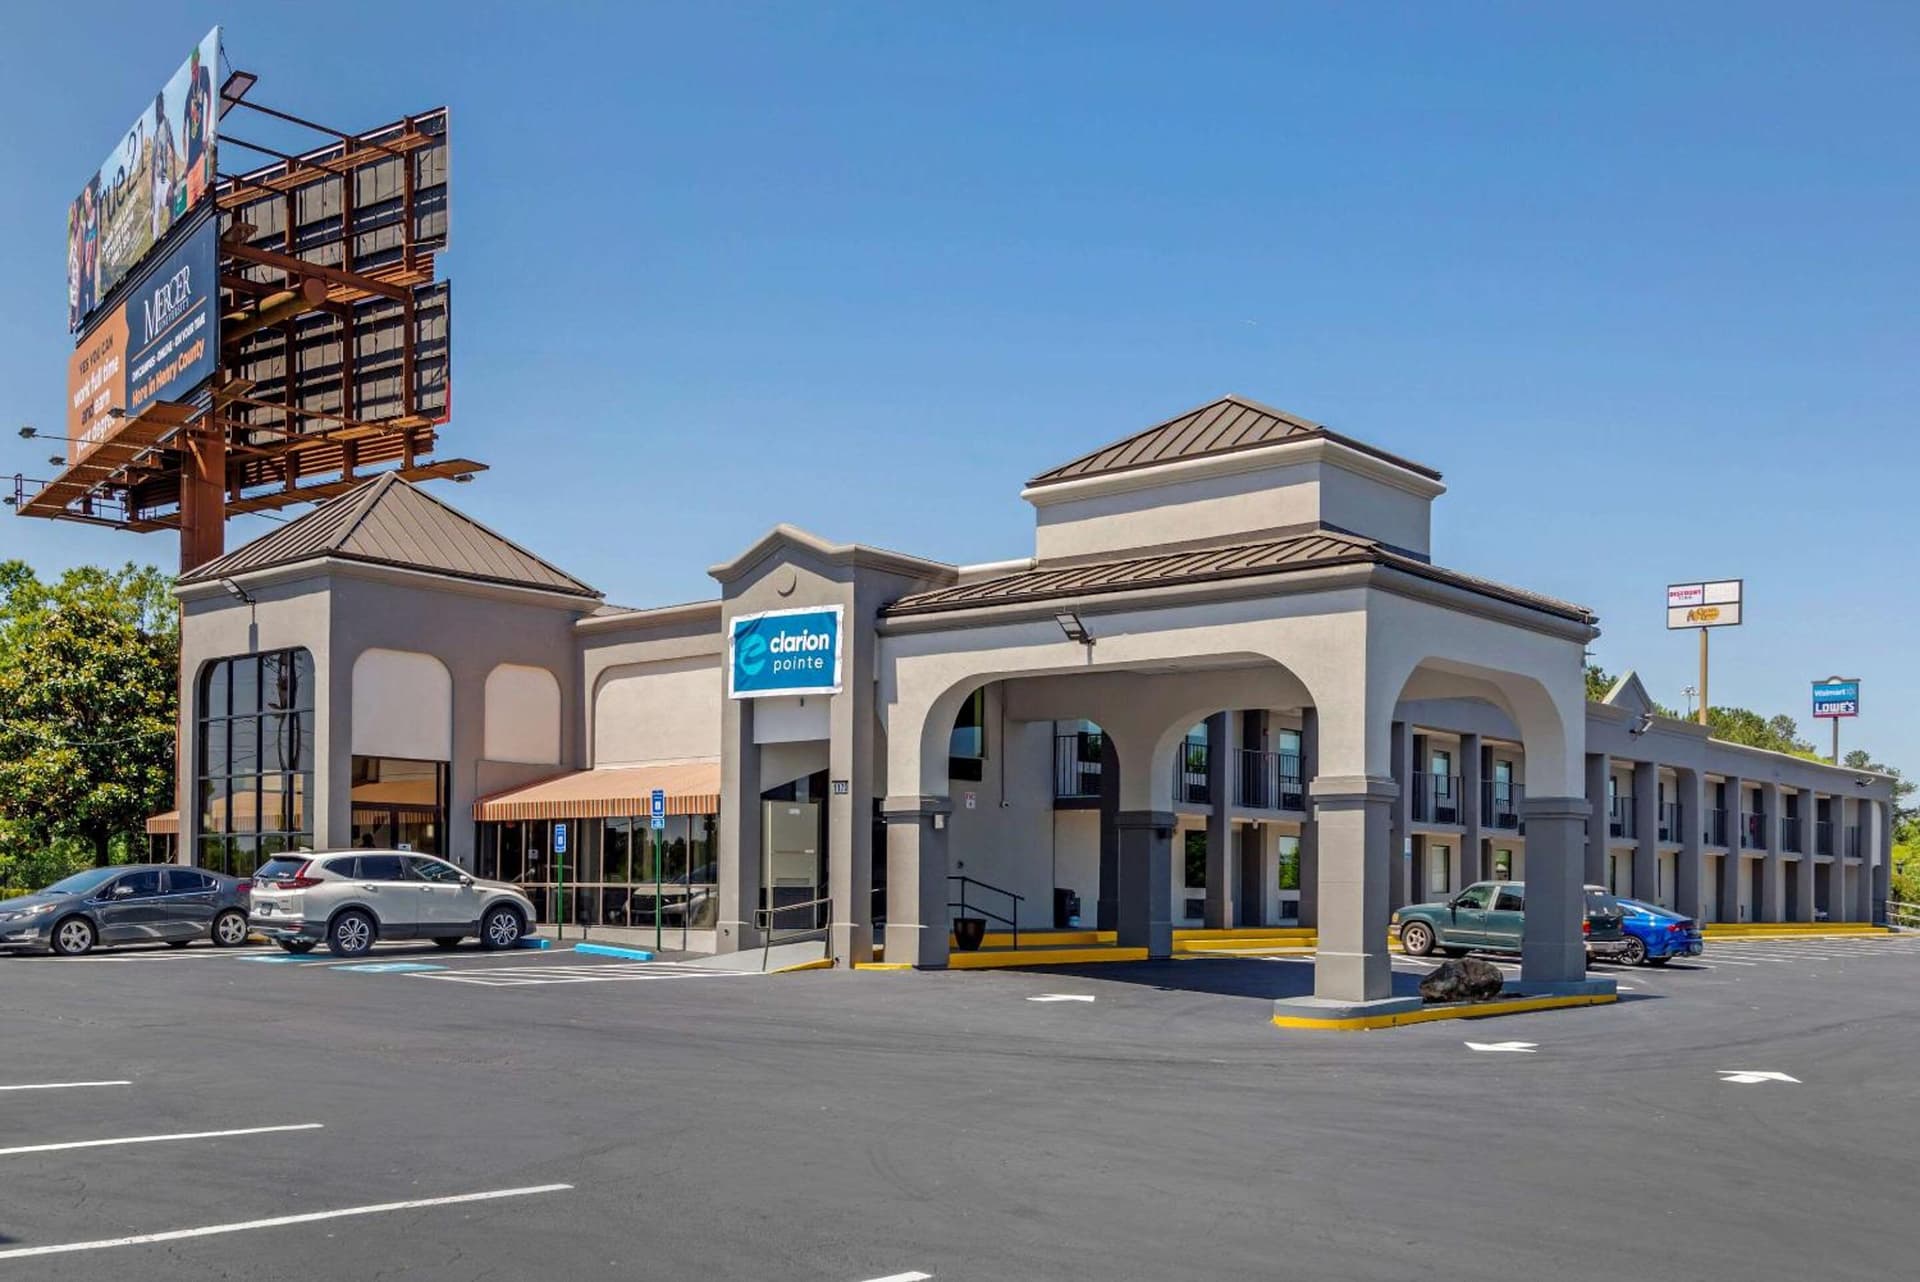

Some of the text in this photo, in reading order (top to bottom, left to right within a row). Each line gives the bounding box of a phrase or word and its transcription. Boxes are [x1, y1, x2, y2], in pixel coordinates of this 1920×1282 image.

[100, 119, 147, 223] rue21
[144, 265, 191, 345] MERCER
[178, 338, 205, 373] County
[770, 629, 830, 654] clarion
[773, 656, 824, 674] pointe
[1815, 701, 1855, 713] LOWE'S
